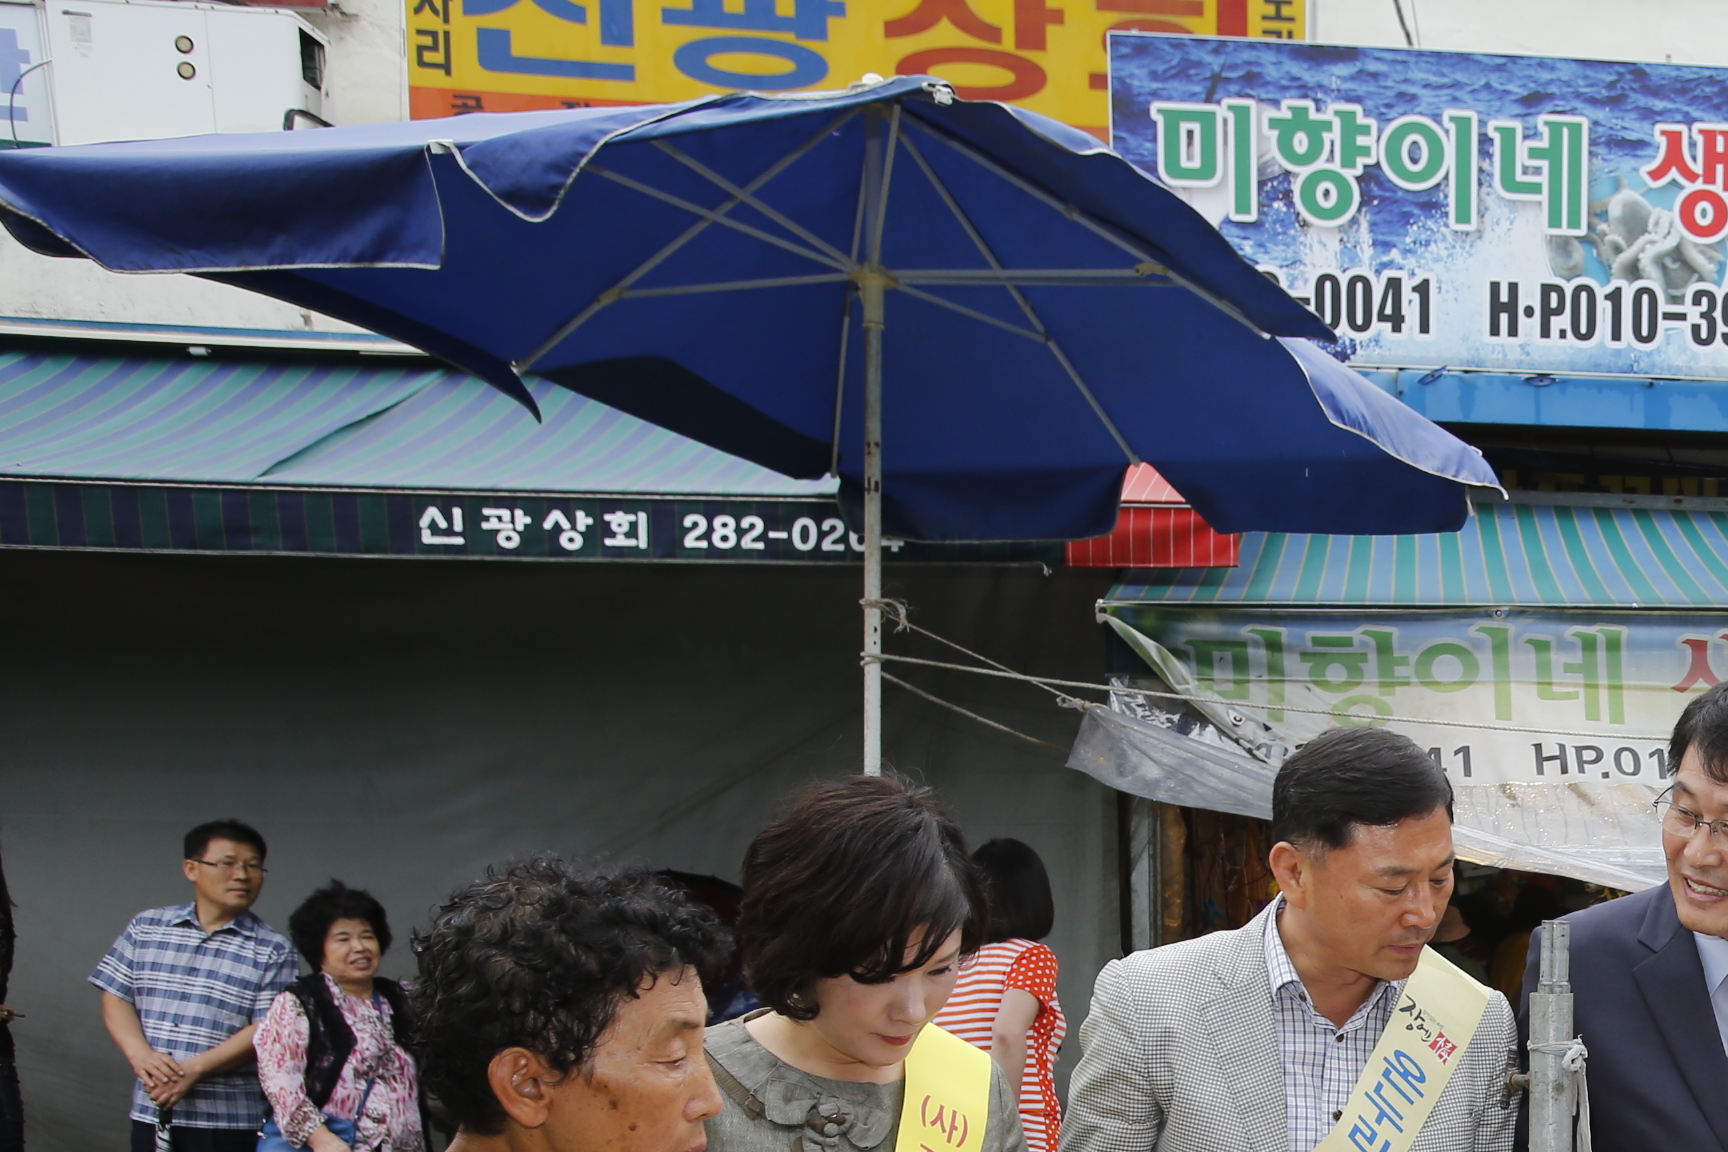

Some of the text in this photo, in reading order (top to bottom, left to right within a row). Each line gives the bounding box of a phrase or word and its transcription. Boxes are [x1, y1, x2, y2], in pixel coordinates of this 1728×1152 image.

[1151, 97, 1590, 237] 미향이네
[419, 505, 648, 550] 신광상회
[1181, 625, 1628, 728] 미향이네
